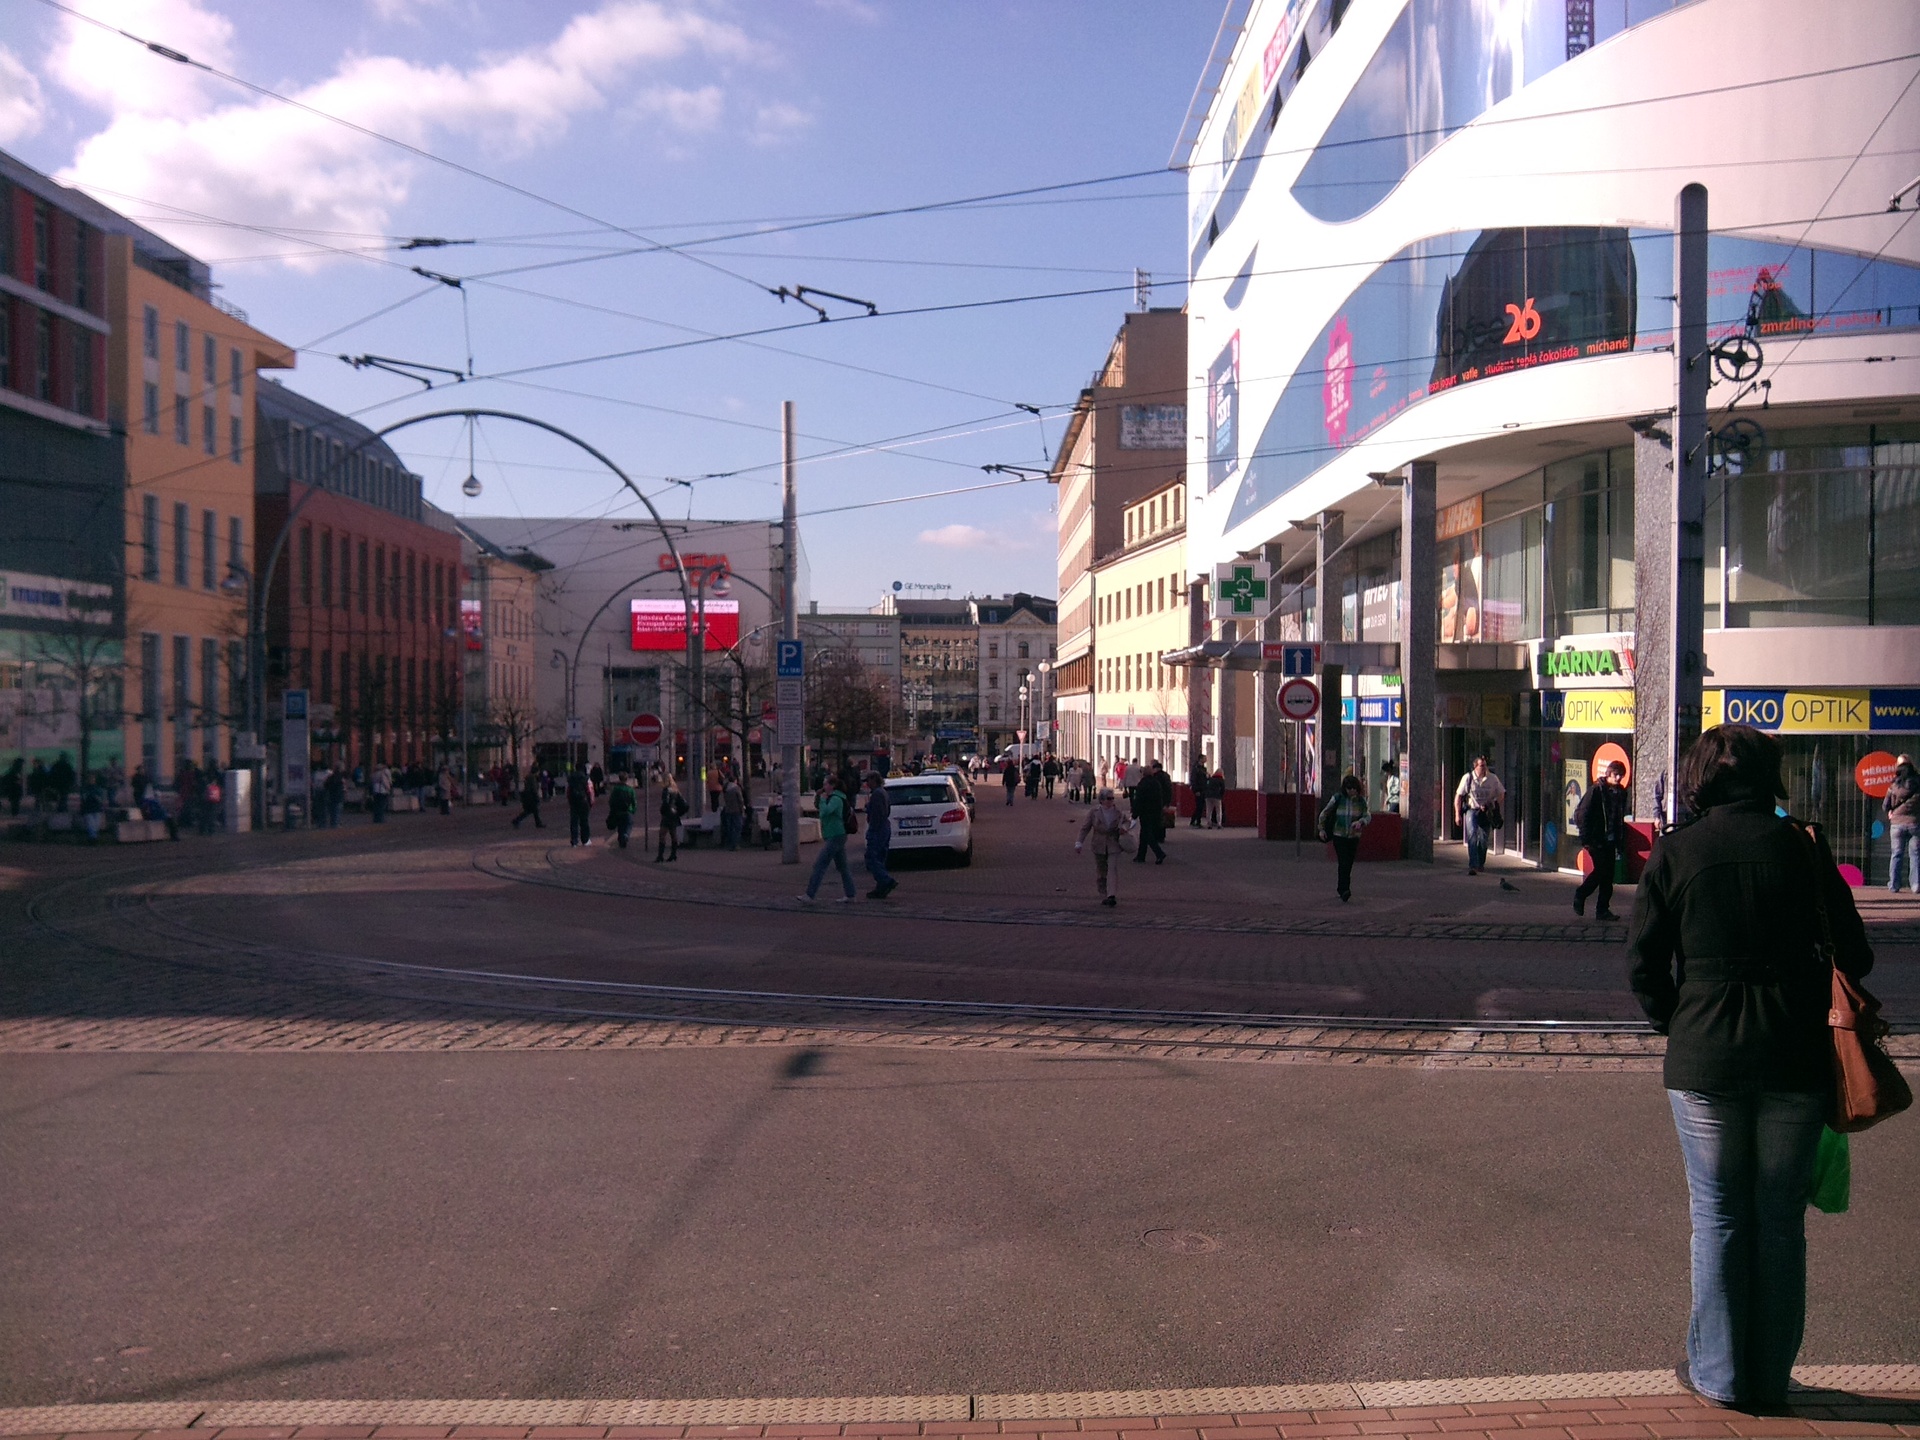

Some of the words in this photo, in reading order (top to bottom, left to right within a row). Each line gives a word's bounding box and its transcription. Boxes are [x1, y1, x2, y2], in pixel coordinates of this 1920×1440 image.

[1503, 297, 1541, 344] 26
[1539, 344, 1579, 362] čokoláda
[781, 643, 797, 666] P
[1568, 700, 1604, 721] OPTIK
[1728, 699, 1779, 723] OKO
[1791, 699, 1863, 723] OPTIK
